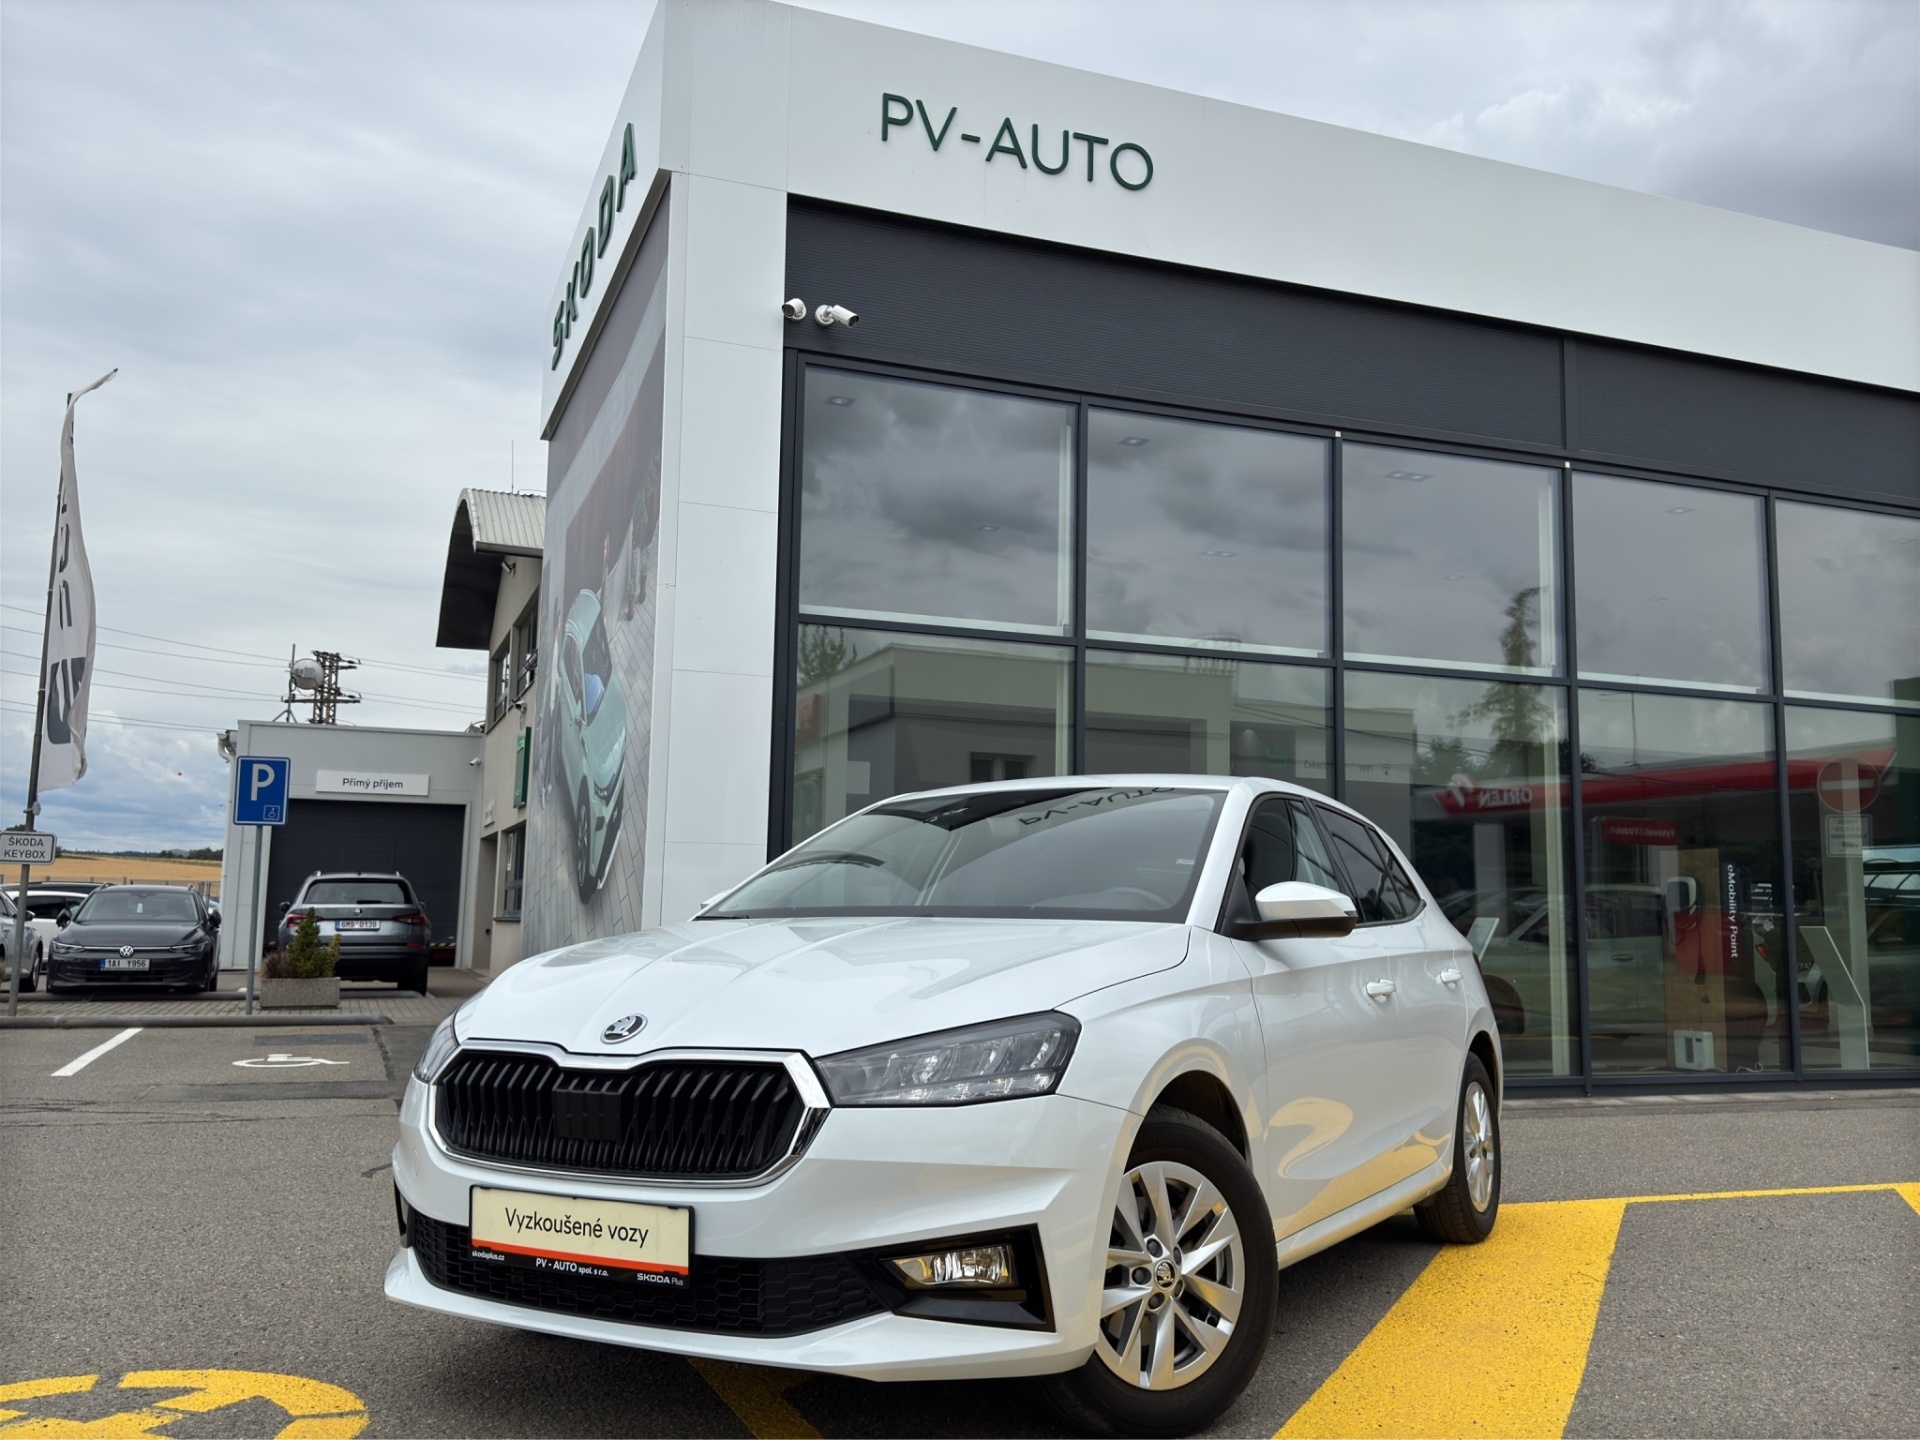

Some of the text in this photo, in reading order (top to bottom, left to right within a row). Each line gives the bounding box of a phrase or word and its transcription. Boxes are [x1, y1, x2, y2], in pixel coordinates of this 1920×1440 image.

[881, 92, 1154, 191] PV-AUTO
[250, 763, 275, 801] P
[8, 835, 44, 847] ŠKODA
[4, 849, 46, 859] KEYBOX
[1727, 864, 1739, 959] eMobility Point
[504, 1207, 649, 1249] Vyzkoušené vozy
[471, 1249, 505, 1261] skodaplus.cz
[535, 1257, 548, 1268] PV
[553, 1260, 578, 1272] AUTO
[578, 1266, 593, 1275] spol.
[671, 1276, 684, 1287] Plus
